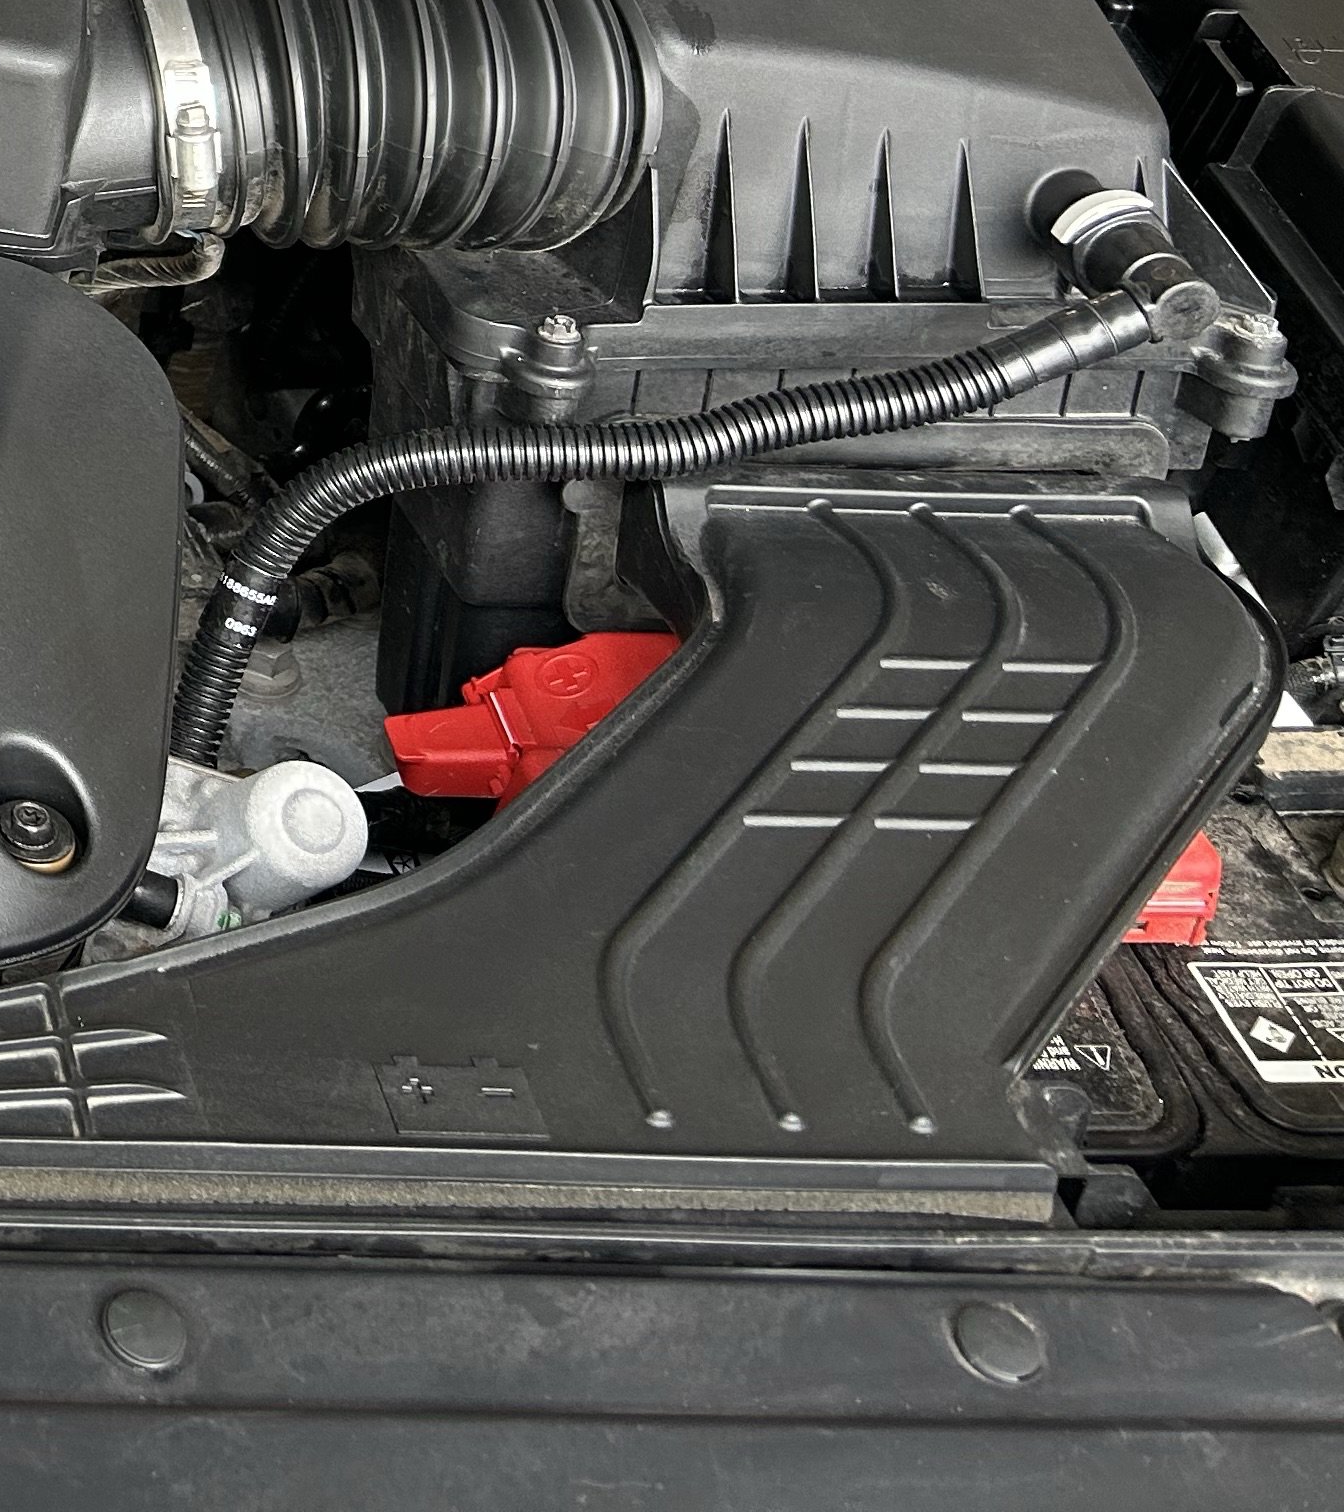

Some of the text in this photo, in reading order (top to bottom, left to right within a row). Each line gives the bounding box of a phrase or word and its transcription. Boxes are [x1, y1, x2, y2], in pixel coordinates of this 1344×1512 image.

[1292, 979, 1314, 988] NOT
[1314, 978, 1333, 988] DO
[1032, 1057, 1081, 1071] WARNI
